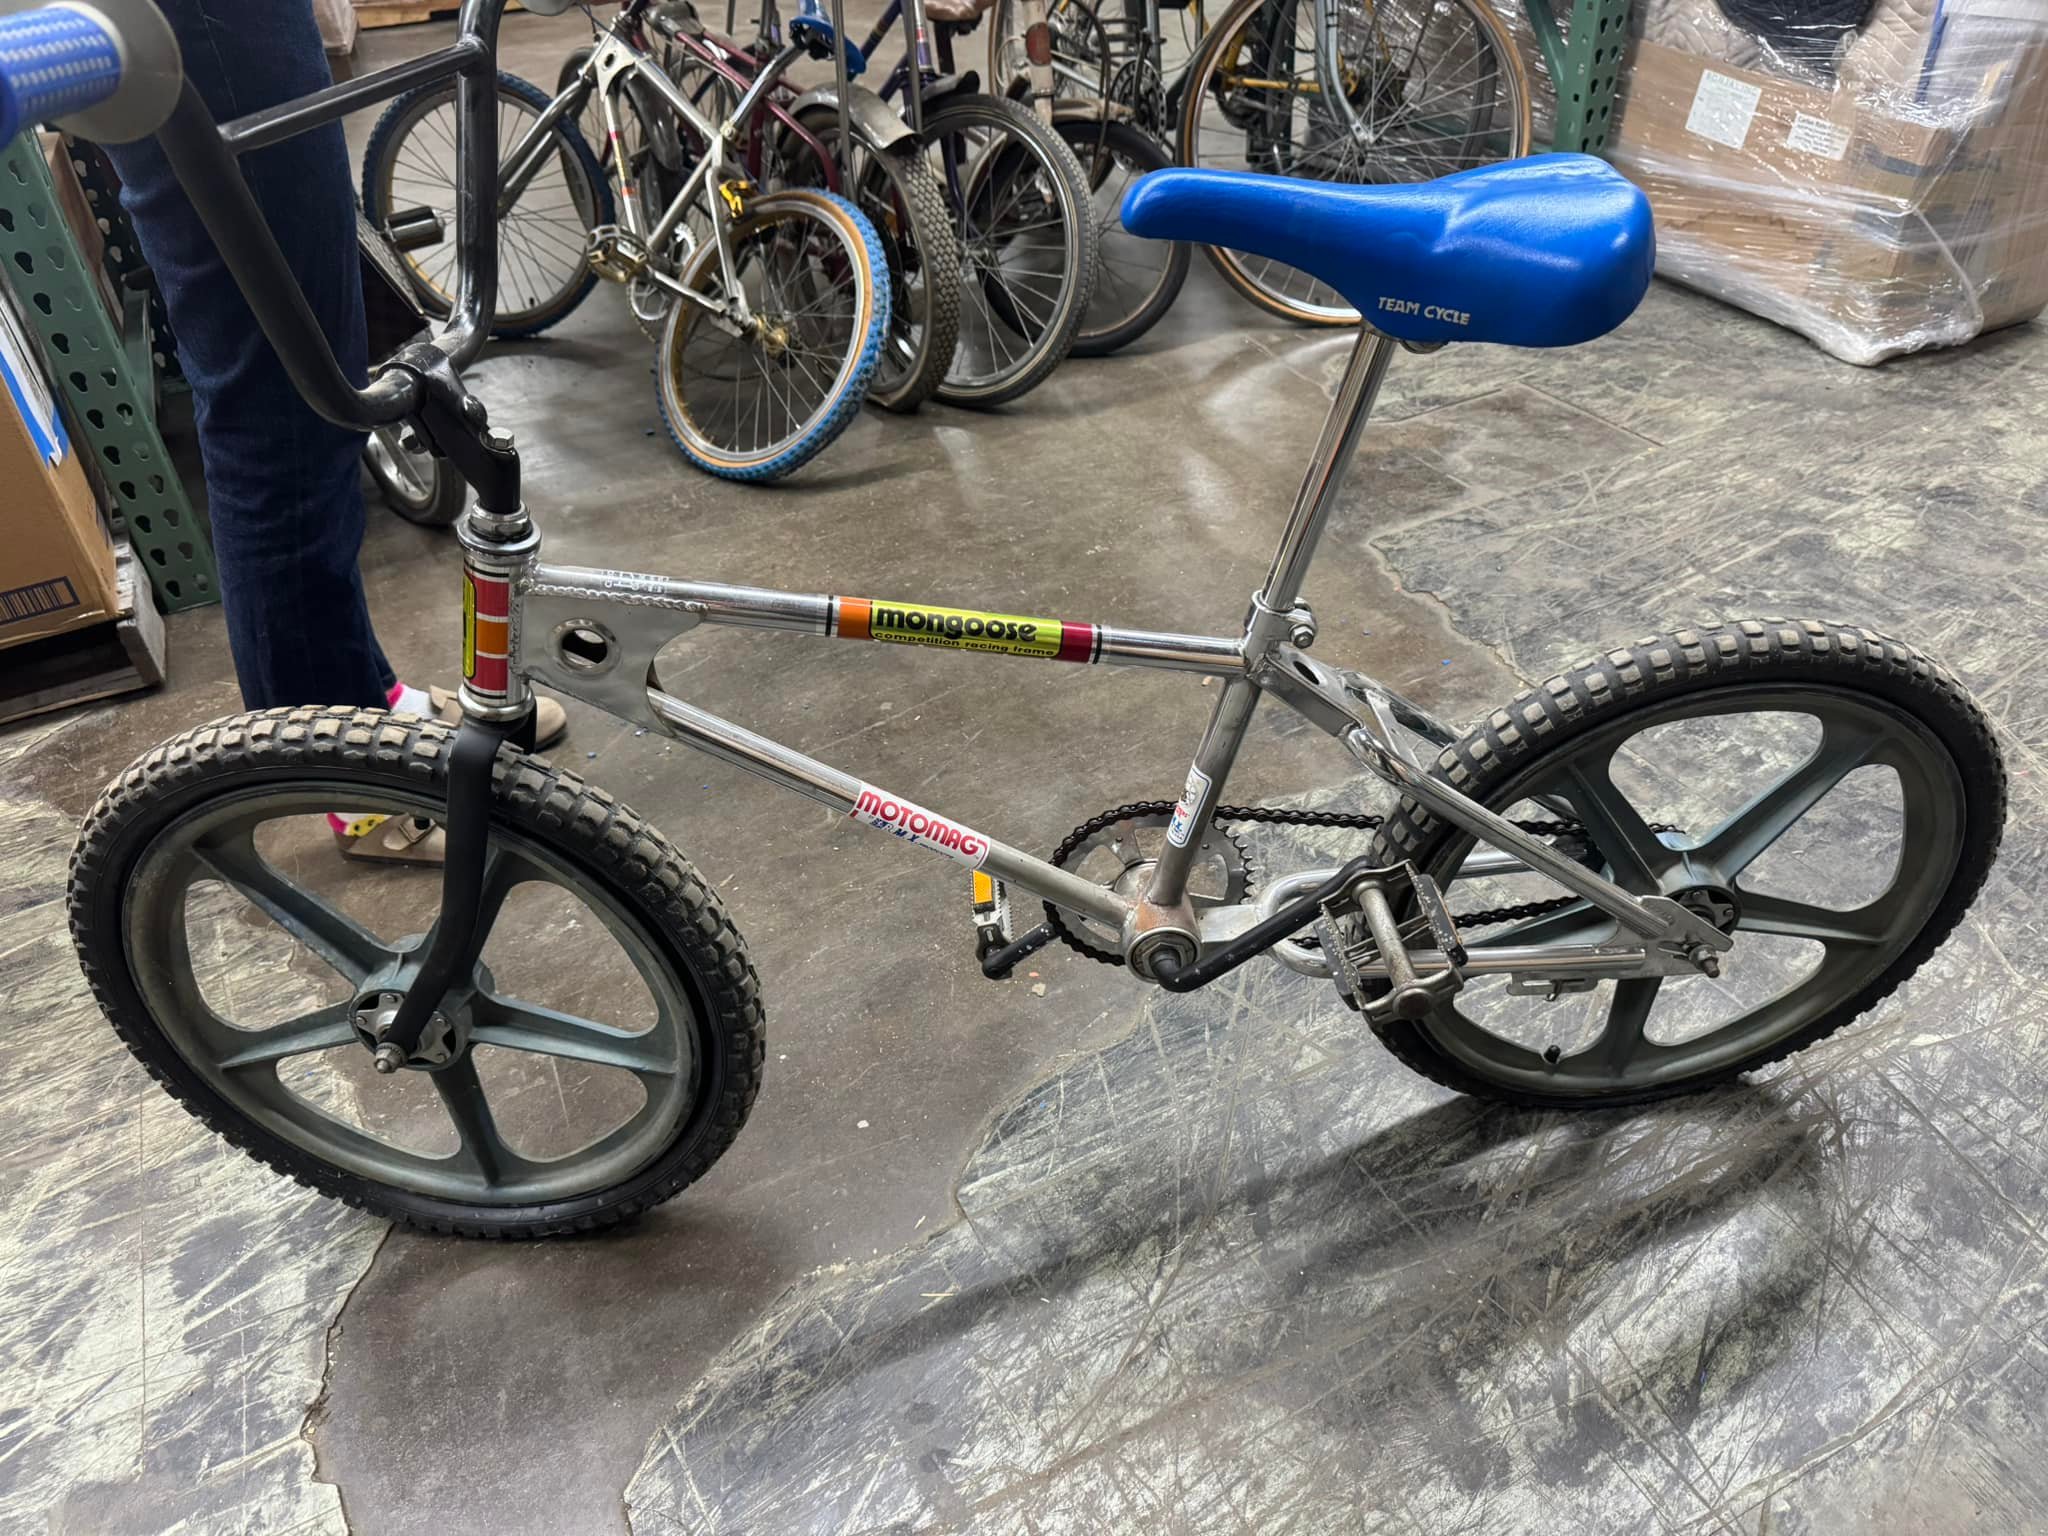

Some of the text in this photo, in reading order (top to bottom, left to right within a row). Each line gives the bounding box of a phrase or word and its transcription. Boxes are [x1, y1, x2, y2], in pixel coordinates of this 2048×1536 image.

[1378, 296, 1471, 325] TEAM CYCLE
[875, 607, 1038, 642] mongoose
[874, 631, 1055, 657] competition racing frame
[857, 790, 980, 856] MOTOMAG
